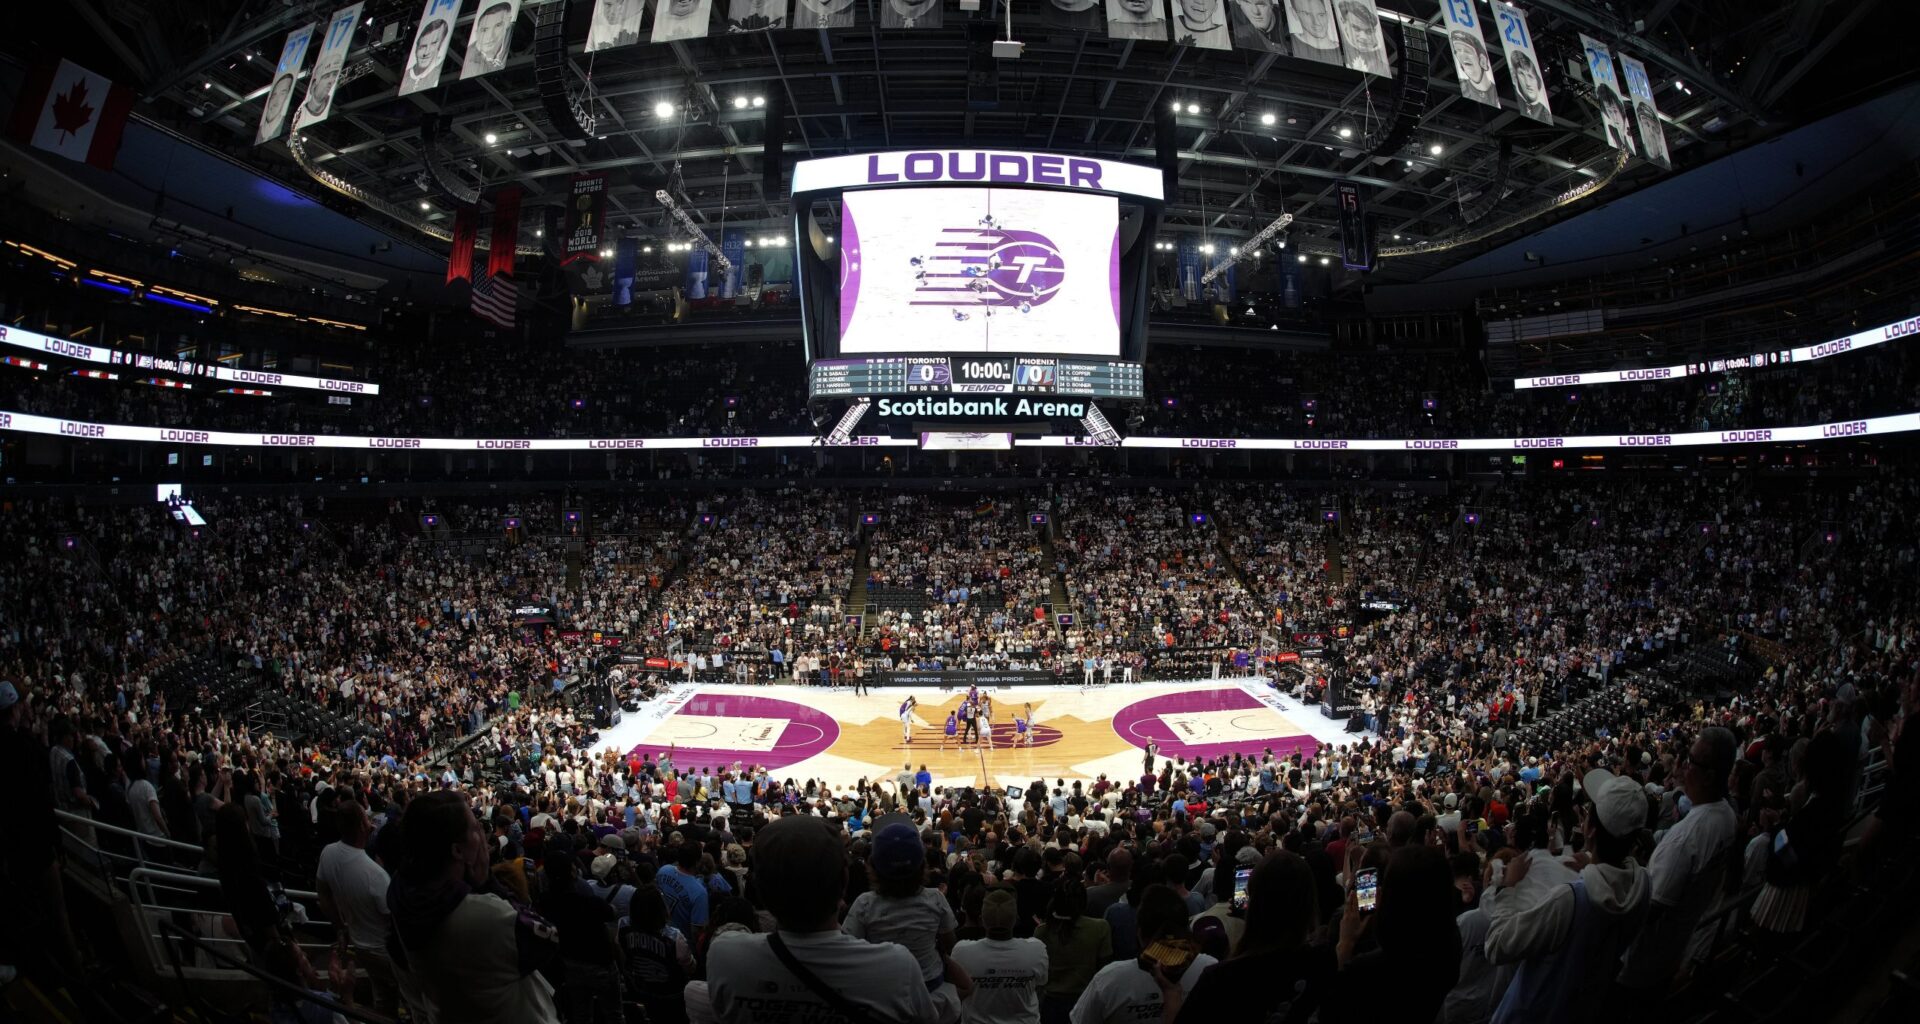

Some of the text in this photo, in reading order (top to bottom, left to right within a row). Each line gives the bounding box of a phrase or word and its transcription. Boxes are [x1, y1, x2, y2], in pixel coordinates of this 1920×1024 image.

[327, 16, 354, 50] 17
[1500, 13, 1528, 48] 21
[868, 152, 1102, 188] LOUDER
[1342, 193, 1357, 212] 15
[568, 235, 597, 246] WORLD
[1012, 256, 1047, 284] T
[1885, 317, 1920, 340] LOUDE
[45, 338, 92, 360] LOUDER
[1810, 338, 1852, 358] LOUDER
[125, 352, 132, 364] 0
[1771, 352, 1777, 363] 0
[232, 370, 282, 384] LOUDER
[921, 365, 934, 381] 0
[962, 362, 1002, 379] 10:00
[1030, 366, 1042, 382] 0
[1620, 368, 1671, 381] LOUDER
[319, 380, 364, 392] LOUDER
[1532, 375, 1580, 387] LOUDER
[878, 396, 1083, 417] Scotiabank Arena
[60, 422, 104, 437] LOUDER
[1722, 430, 1772, 442] LOUDER
[1824, 422, 1867, 438] LOUDER
[161, 430, 209, 443] LOUDER
[262, 435, 315, 446] LOUDER
[370, 438, 420, 448] LOUDER
[703, 437, 758, 447] LOUDER
[1514, 438, 1563, 448] LOUDER
[1620, 435, 1671, 446] LOUDER
[477, 440, 530, 449] LOUDER
[590, 439, 644, 449] LOUDER
[1182, 439, 1236, 448] LOUDER
[1294, 440, 1348, 449] LOUDER
[1406, 439, 1458, 449] LOUDER
